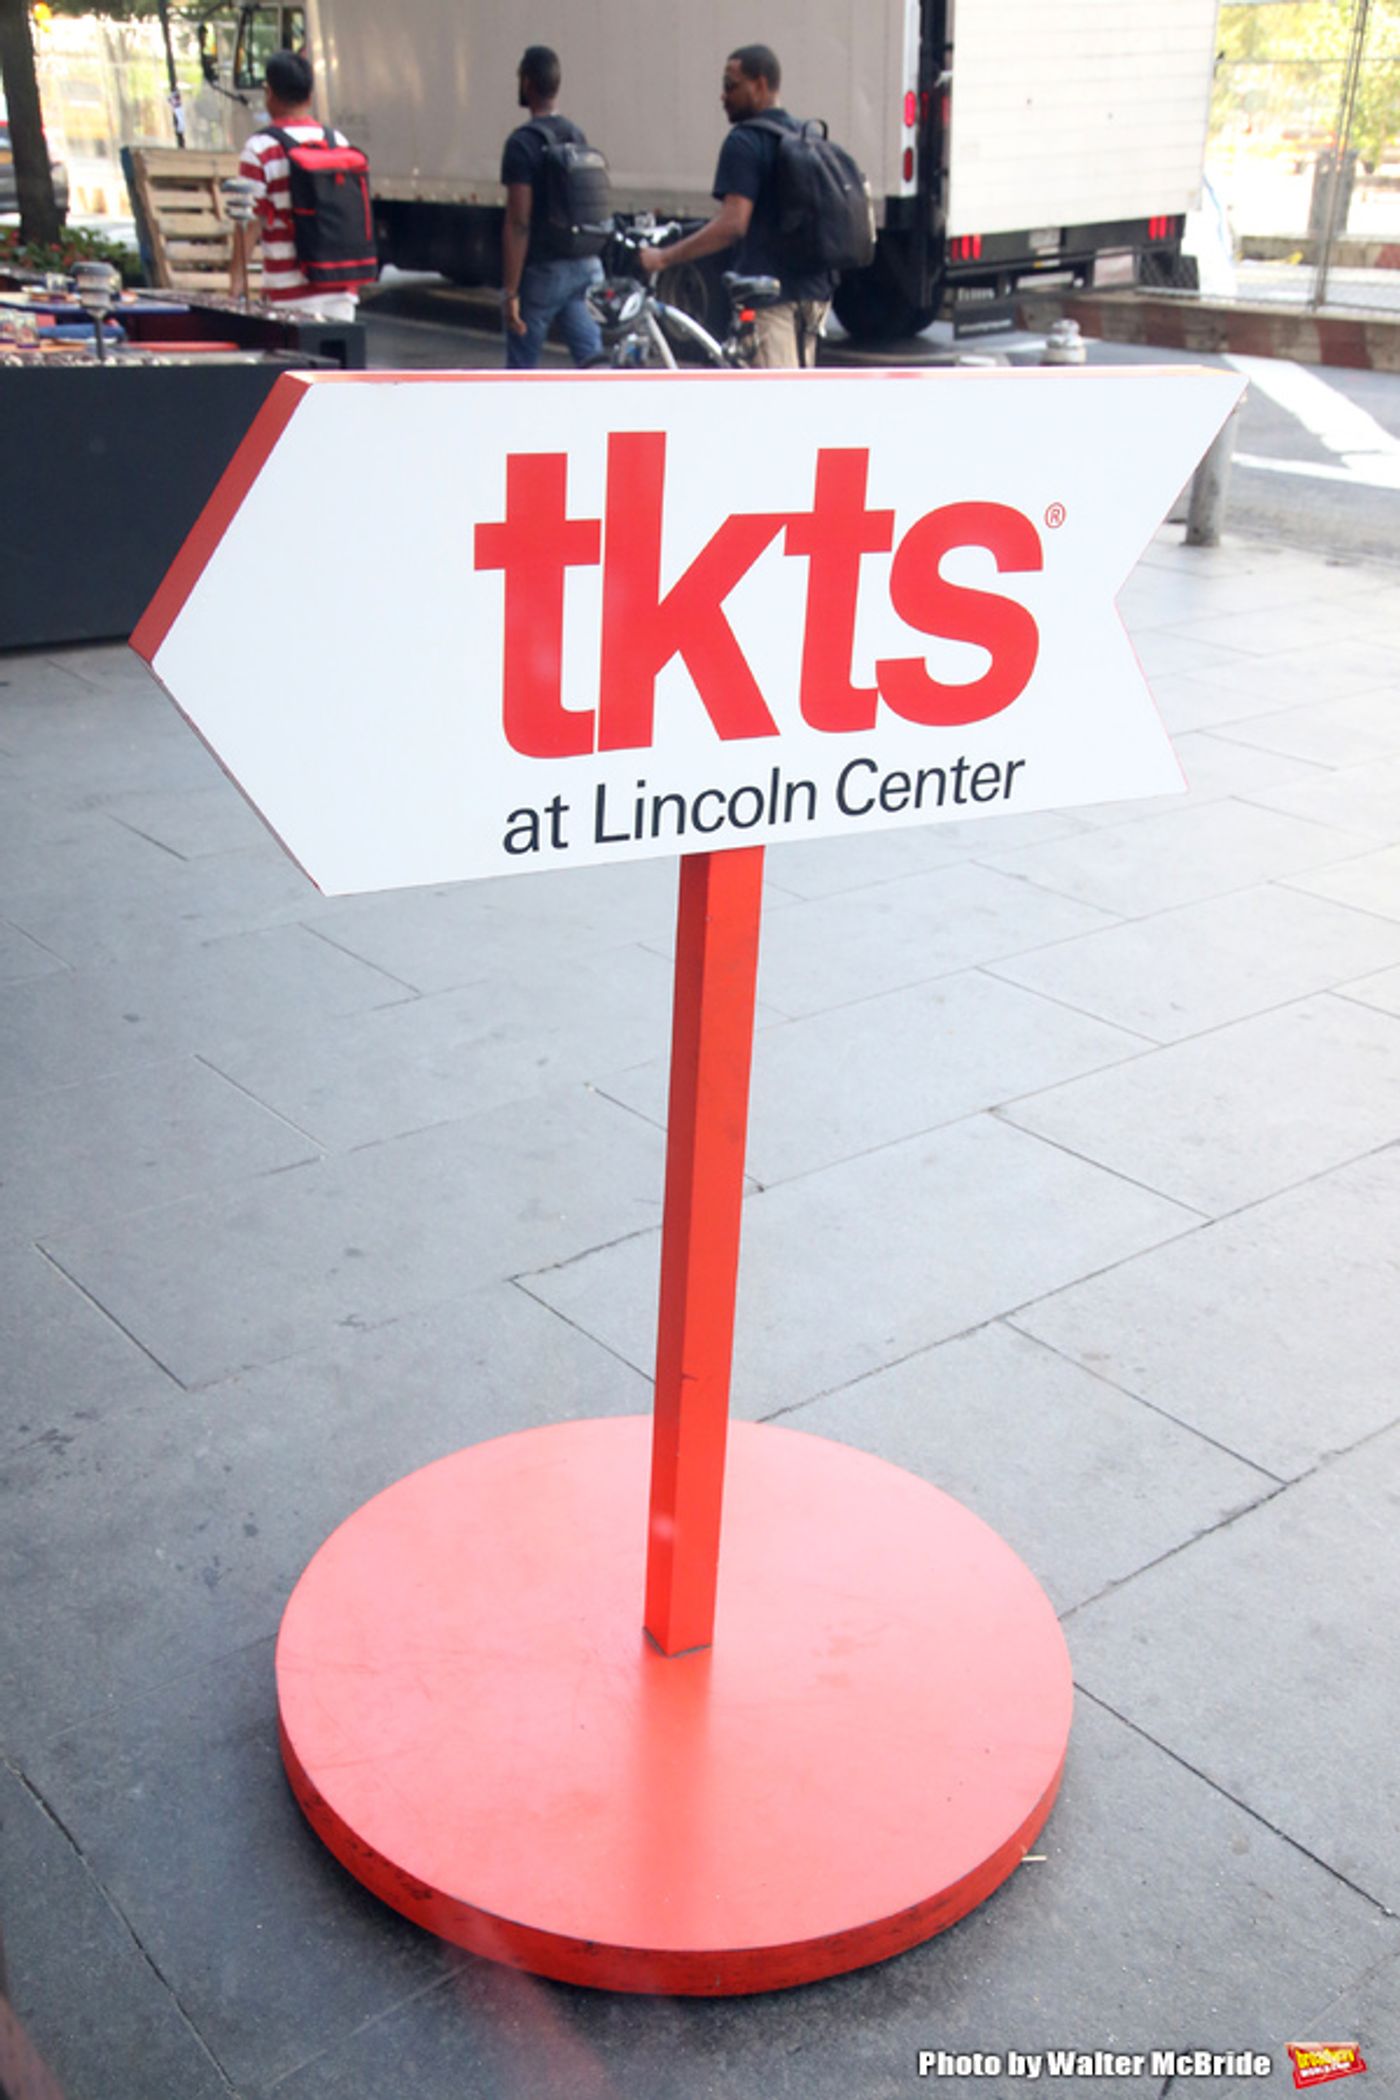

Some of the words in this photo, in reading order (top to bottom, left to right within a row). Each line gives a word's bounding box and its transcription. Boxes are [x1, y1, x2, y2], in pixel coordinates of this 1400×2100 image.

[503, 795, 570, 855] at
[595, 767, 817, 844] Lincoln
[836, 756, 1025, 816] Center
